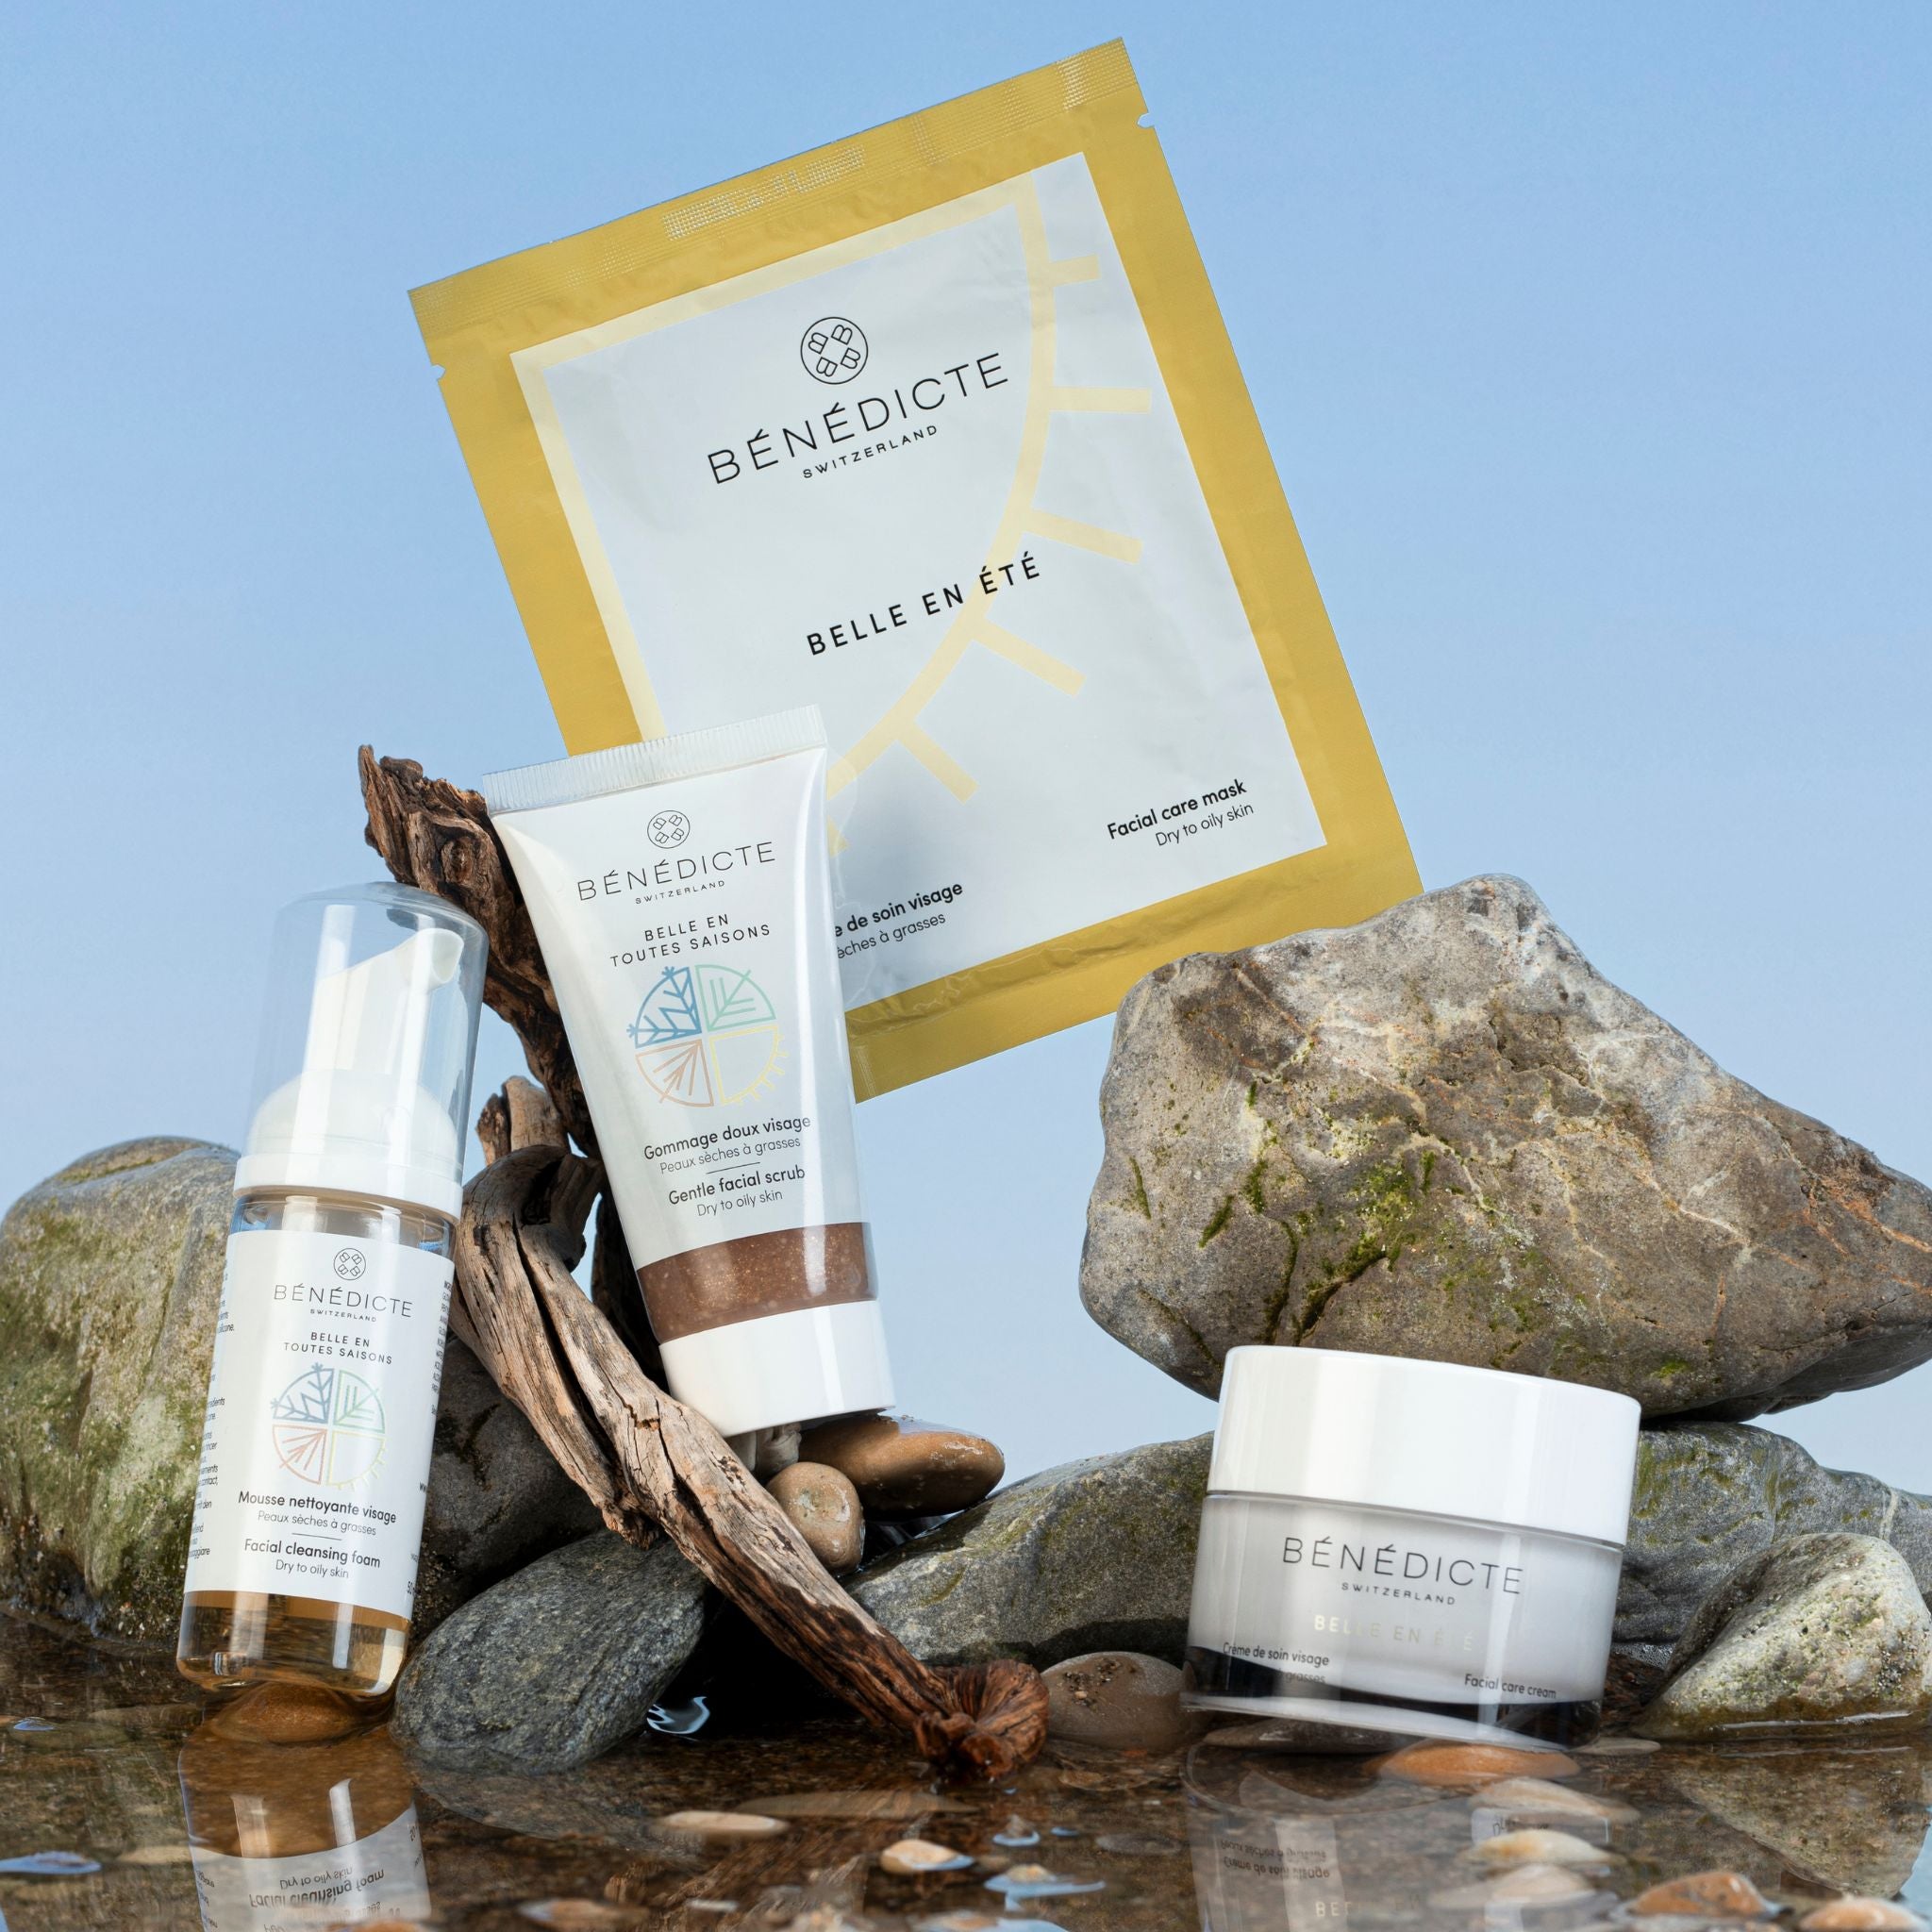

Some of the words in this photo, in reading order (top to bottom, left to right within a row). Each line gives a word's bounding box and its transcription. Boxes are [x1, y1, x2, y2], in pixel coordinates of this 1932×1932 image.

[708, 353, 1008, 484] BÉNÉDICTE
[803, 425, 938, 479] SWITZERLAND
[807, 604, 908, 656] BELLE
[923, 582, 964, 616] EN
[979, 551, 1041, 595] ÉTÉ
[1108, 808, 1158, 840] Facial
[1161, 798, 1199, 819] care
[1202, 779, 1247, 806] mask
[1156, 828, 1180, 846] Dry
[1183, 822, 1197, 836] to
[1201, 812, 1224, 829] oily
[1226, 804, 1254, 821] skin
[576, 841, 775, 901] BÉNÉDICTE
[635, 880, 725, 905] SWITZERLAND
[847, 915, 868, 932] de
[872, 902, 906, 924] soin
[908, 883, 963, 910] visage
[644, 920, 698, 941] BELLE
[707, 913, 729, 928] EN
[837, 937, 876, 958] èches
[879, 930, 890, 943] à
[892, 913, 946, 941] grasses
[610, 941, 681, 967] TOUTES
[690, 924, 771, 950] SAISONS
[643, 1132, 718, 1160] Gommage
[723, 1124, 760, 1141] doux
[762, 1116, 811, 1133] visage
[659, 1158, 696, 1174] Peaux
[698, 1147, 741, 1164] sèches
[743, 1142, 752, 1155] à
[755, 1137, 801, 1157] grasses
[668, 1182, 716, 1205] Gentle
[719, 1171, 761, 1192] facial
[765, 1164, 806, 1184] scrub
[696, 1203, 718, 1217] Dry
[721, 1199, 733, 1210] to
[736, 1192, 757, 1208] oily
[759, 1190, 783, 1204] skin
[274, 1283, 414, 1318] BÉNÉDICTE
[309, 1308, 377, 1323] SWITZERLAND
[284, 1341, 333, 1356] TOUTES
[339, 1348, 393, 1365] SAISONS
[310, 1331, 349, 1344] BELLE
[355, 1338, 370, 1347] EN
[238, 1491, 286, 1507] Mousse
[289, 1495, 359, 1516] nettoyante
[362, 1506, 397, 1525] visage
[258, 1510, 290, 1524] Peaux
[291, 1513, 328, 1528] sèches
[331, 1518, 339, 1529] à
[341, 1522, 377, 1536] grasses
[244, 1539, 282, 1554] Facial
[285, 1541, 348, 1565] cleansing
[352, 1551, 381, 1568] foam
[275, 1559, 293, 1574] Dry
[296, 1561, 308, 1574] to
[309, 1563, 327, 1578] oily
[330, 1567, 349, 1579] skin
[1283, 1536, 1524, 1594] BÉNÉDICTE
[1341, 1582, 1456, 1605] SWITZERLAND
[1393, 1625, 1421, 1643] EN
[1223, 1641, 1251, 1657] Crème
[1253, 1645, 1266, 1658] de
[1268, 1648, 1289, 1661] soin
[1292, 1650, 1329, 1668] visage
[1464, 1674, 1500, 1690] Facial
[1502, 1682, 1524, 1694] care
[1527, 1686, 1557, 1699] cream
